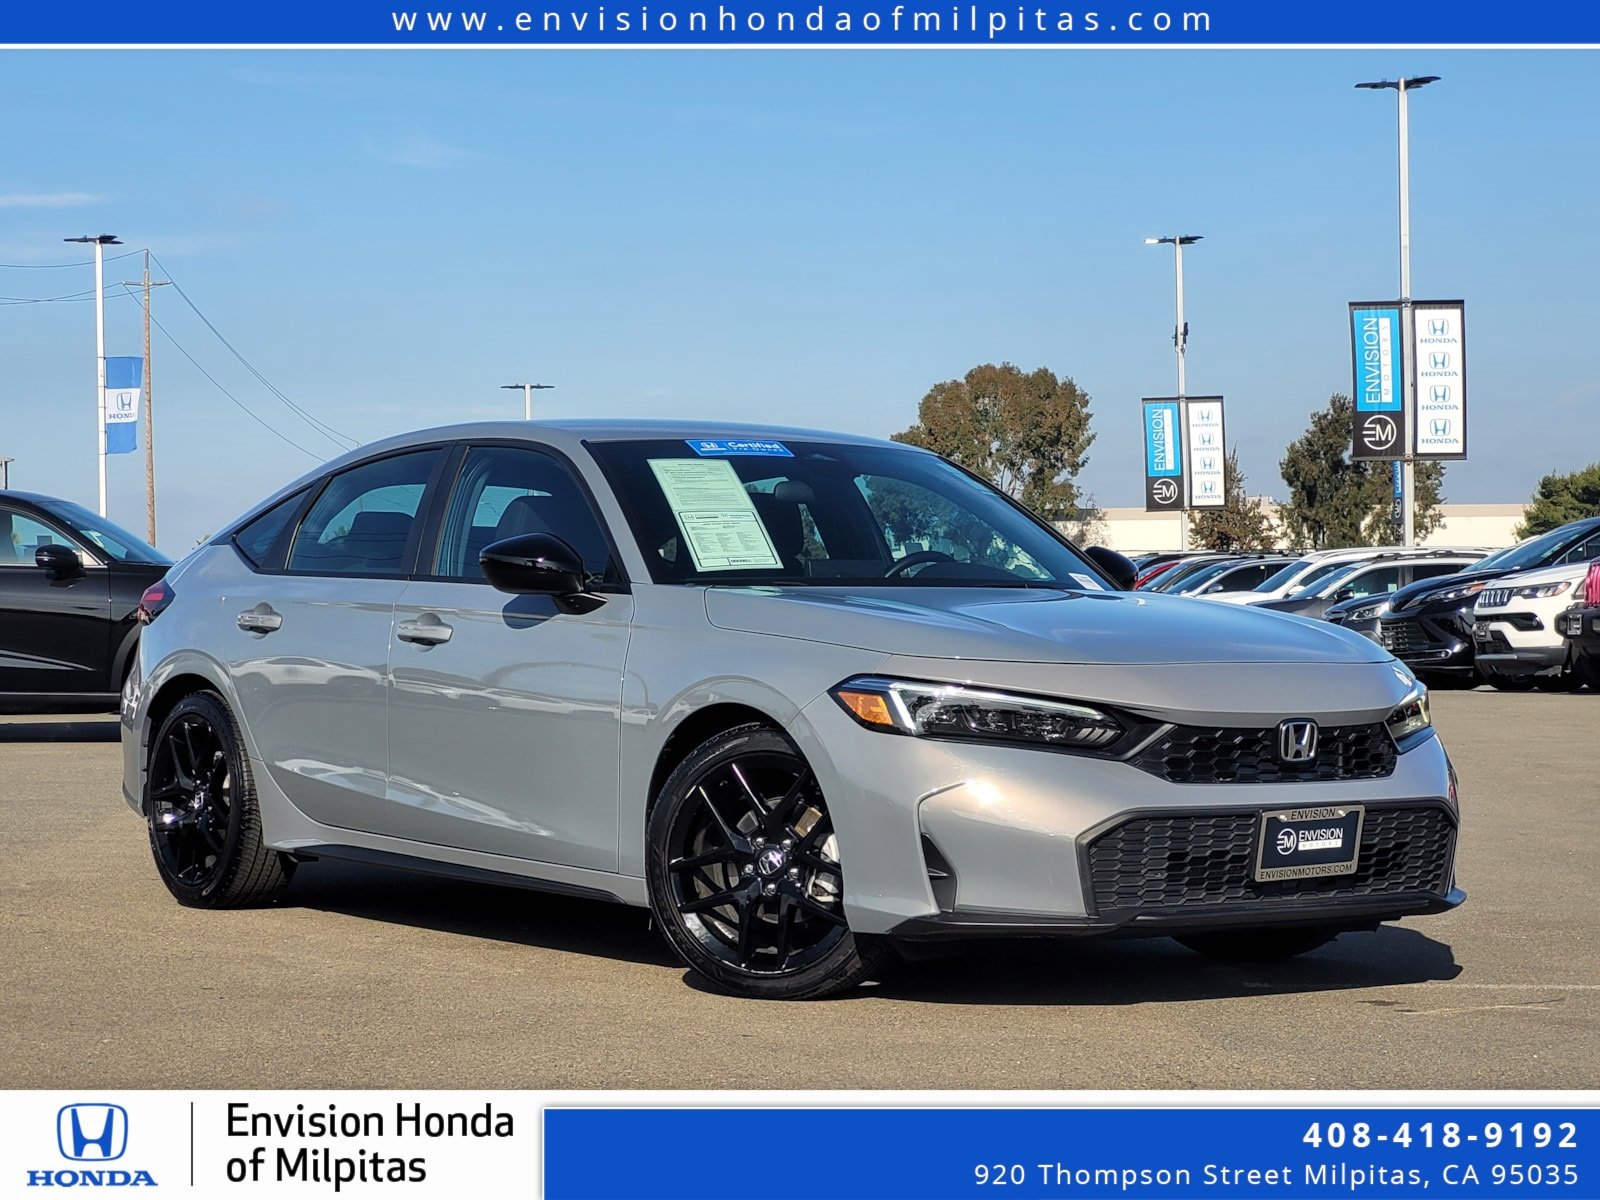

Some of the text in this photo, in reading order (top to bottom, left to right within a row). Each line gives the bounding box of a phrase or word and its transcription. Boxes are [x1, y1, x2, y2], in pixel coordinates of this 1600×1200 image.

[1363, 317, 1380, 403] ENVISION
[1152, 409, 1165, 471] ENVISION
[1291, 808, 1336, 820] ENVISION
[1298, 828, 1344, 842] ENVISION
[1260, 864, 1353, 880] ENVISIONMOTORS.COM
